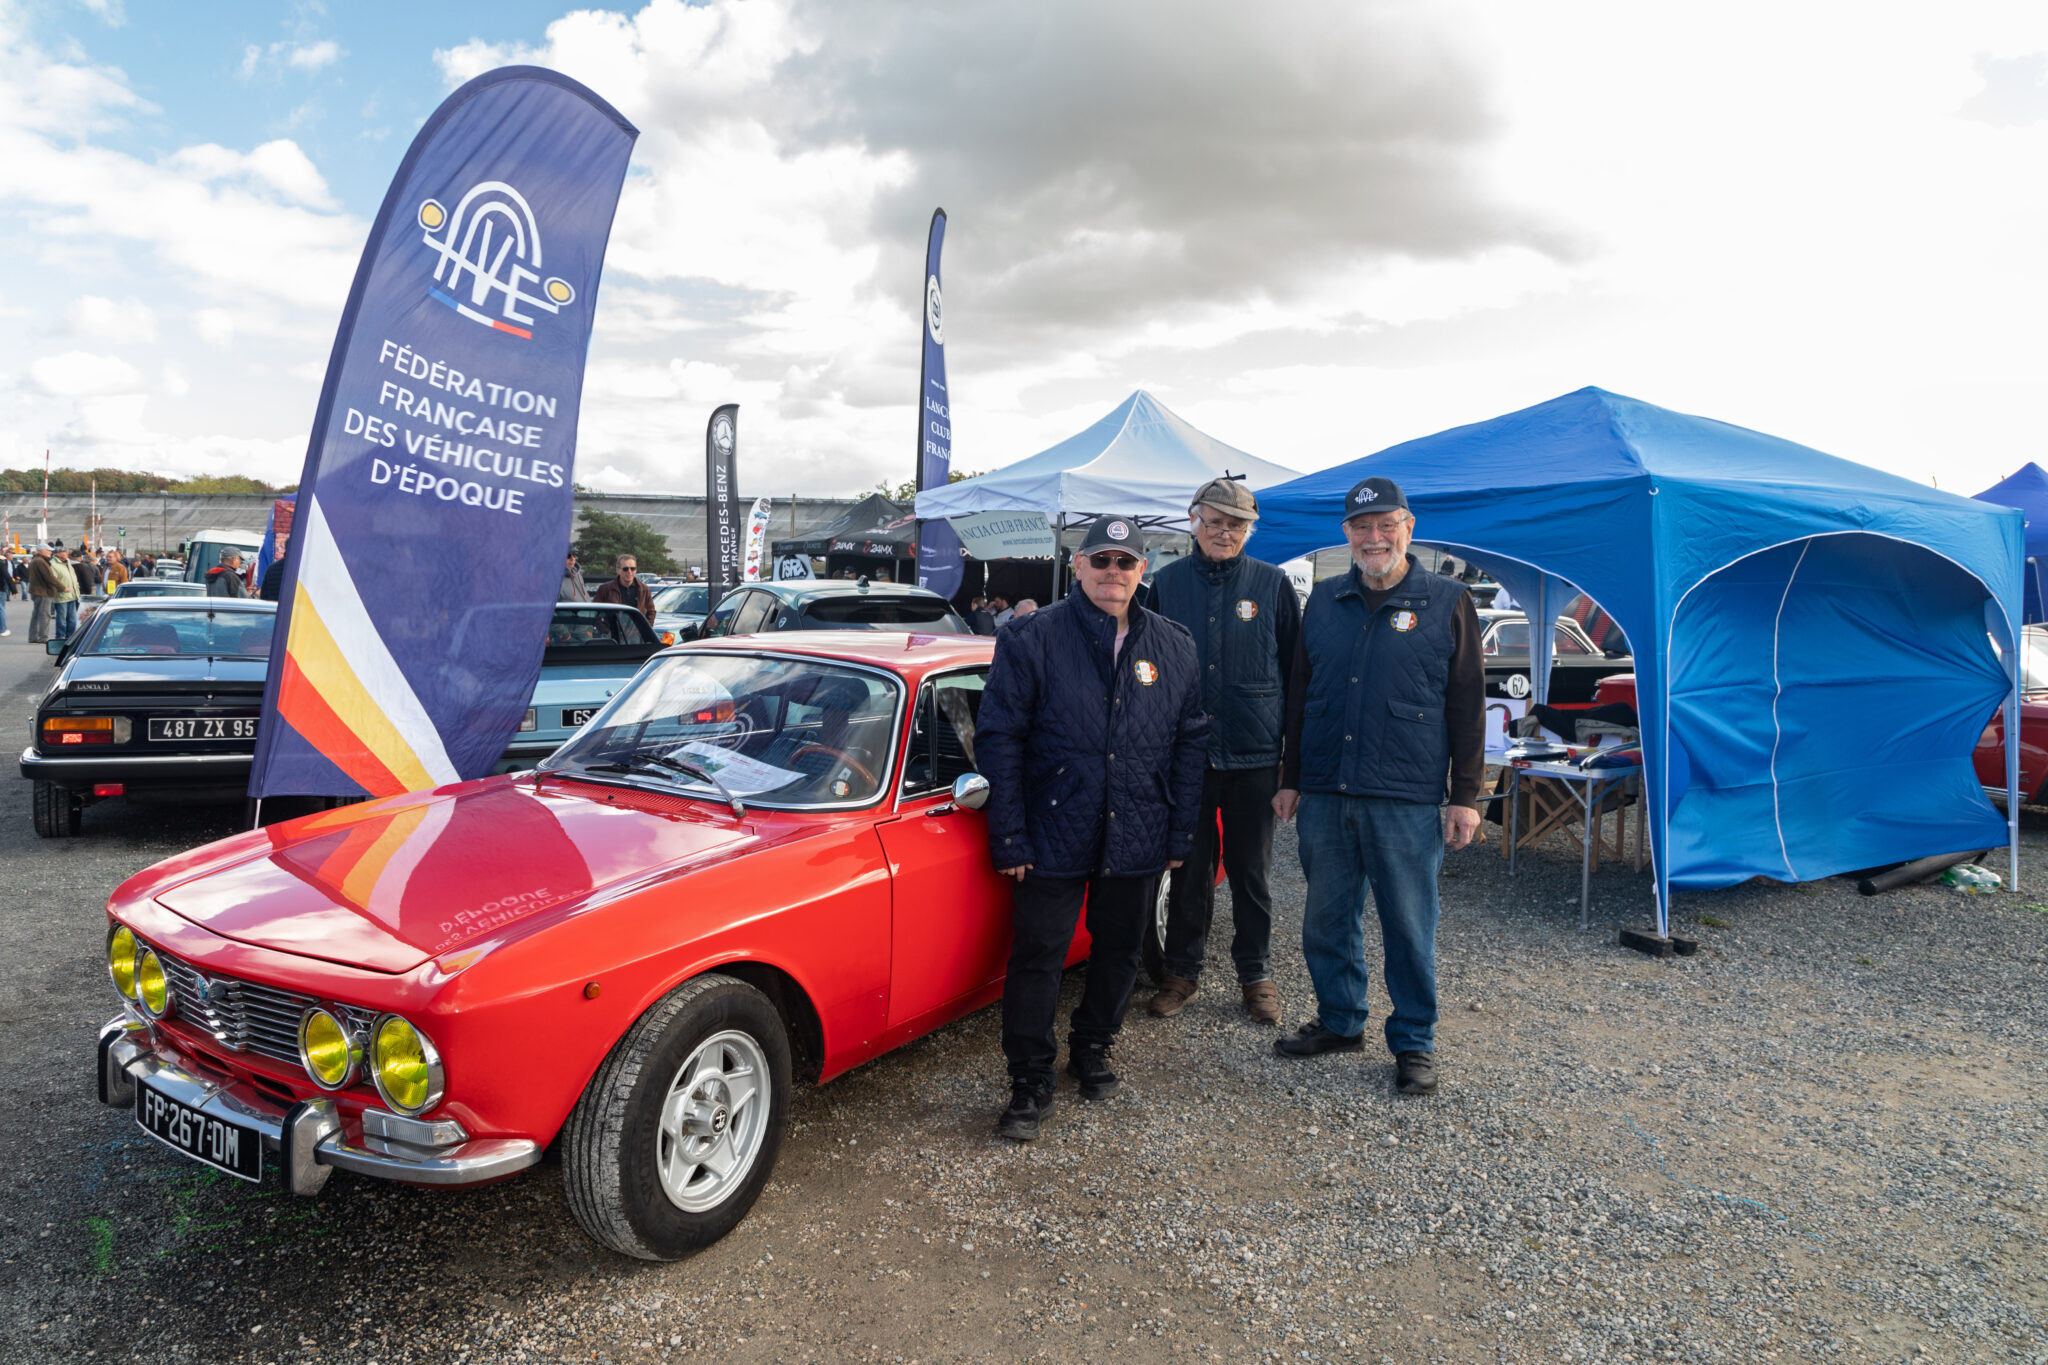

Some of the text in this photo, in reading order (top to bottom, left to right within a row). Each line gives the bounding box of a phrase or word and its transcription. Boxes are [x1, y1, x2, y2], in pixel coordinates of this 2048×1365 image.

[379, 339, 557, 418] FÉDÉRATION
[379, 381, 543, 448] FRANÇAISE
[926, 396, 950, 419] LANCI
[344, 408, 564, 488] DES VÉHICULES
[716, 465, 730, 586] MERCEDES-BENZ
[961, 517, 1048, 540] ANCIA CLUB FRANCE
[870, 544, 893, 555] 24MX
[1512, 676, 1525, 696] 62
[163, 720, 254, 738] 487 ZX 95
